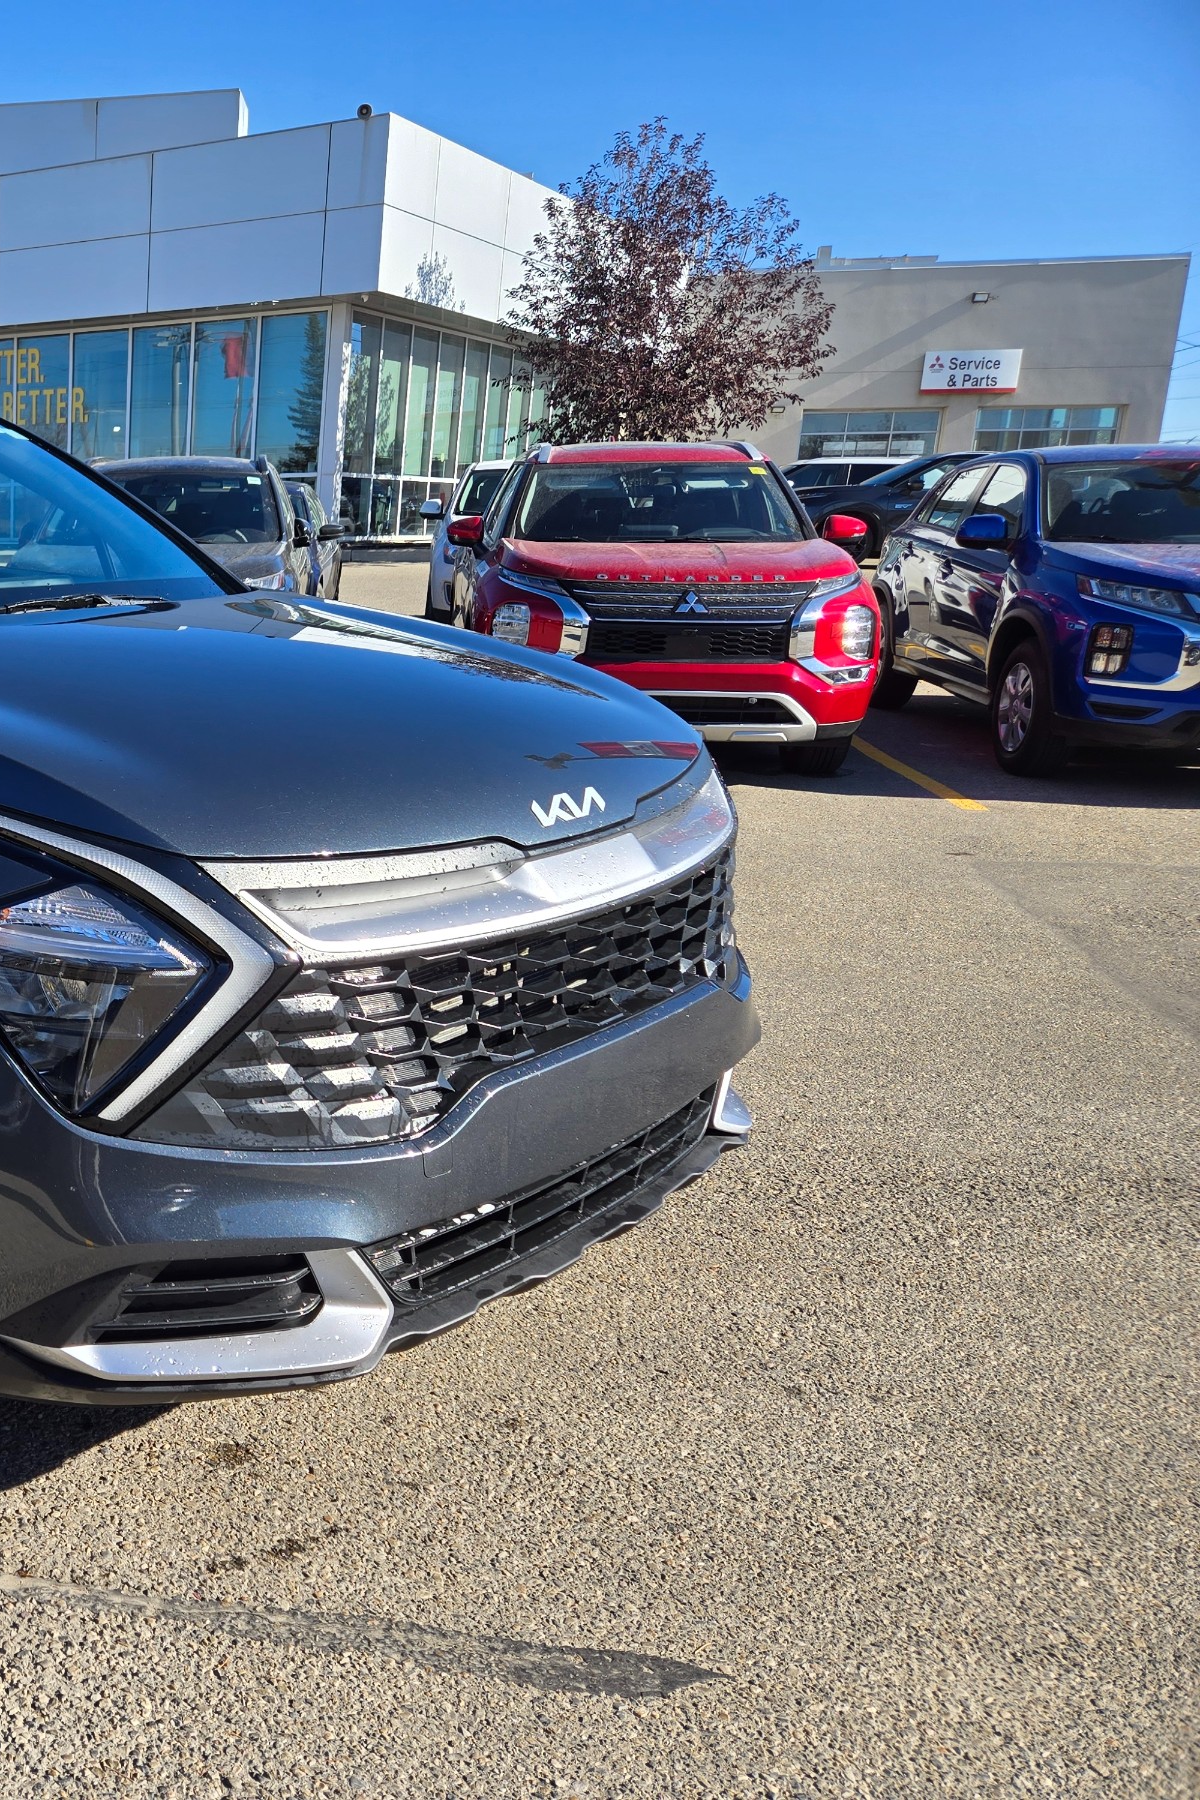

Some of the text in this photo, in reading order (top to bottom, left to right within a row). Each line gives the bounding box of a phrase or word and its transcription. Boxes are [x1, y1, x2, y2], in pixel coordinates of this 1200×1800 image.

[948, 357, 1001, 371] Service
[946, 374, 998, 387] & Parts
[596, 573, 786, 582] OUTLANDER
